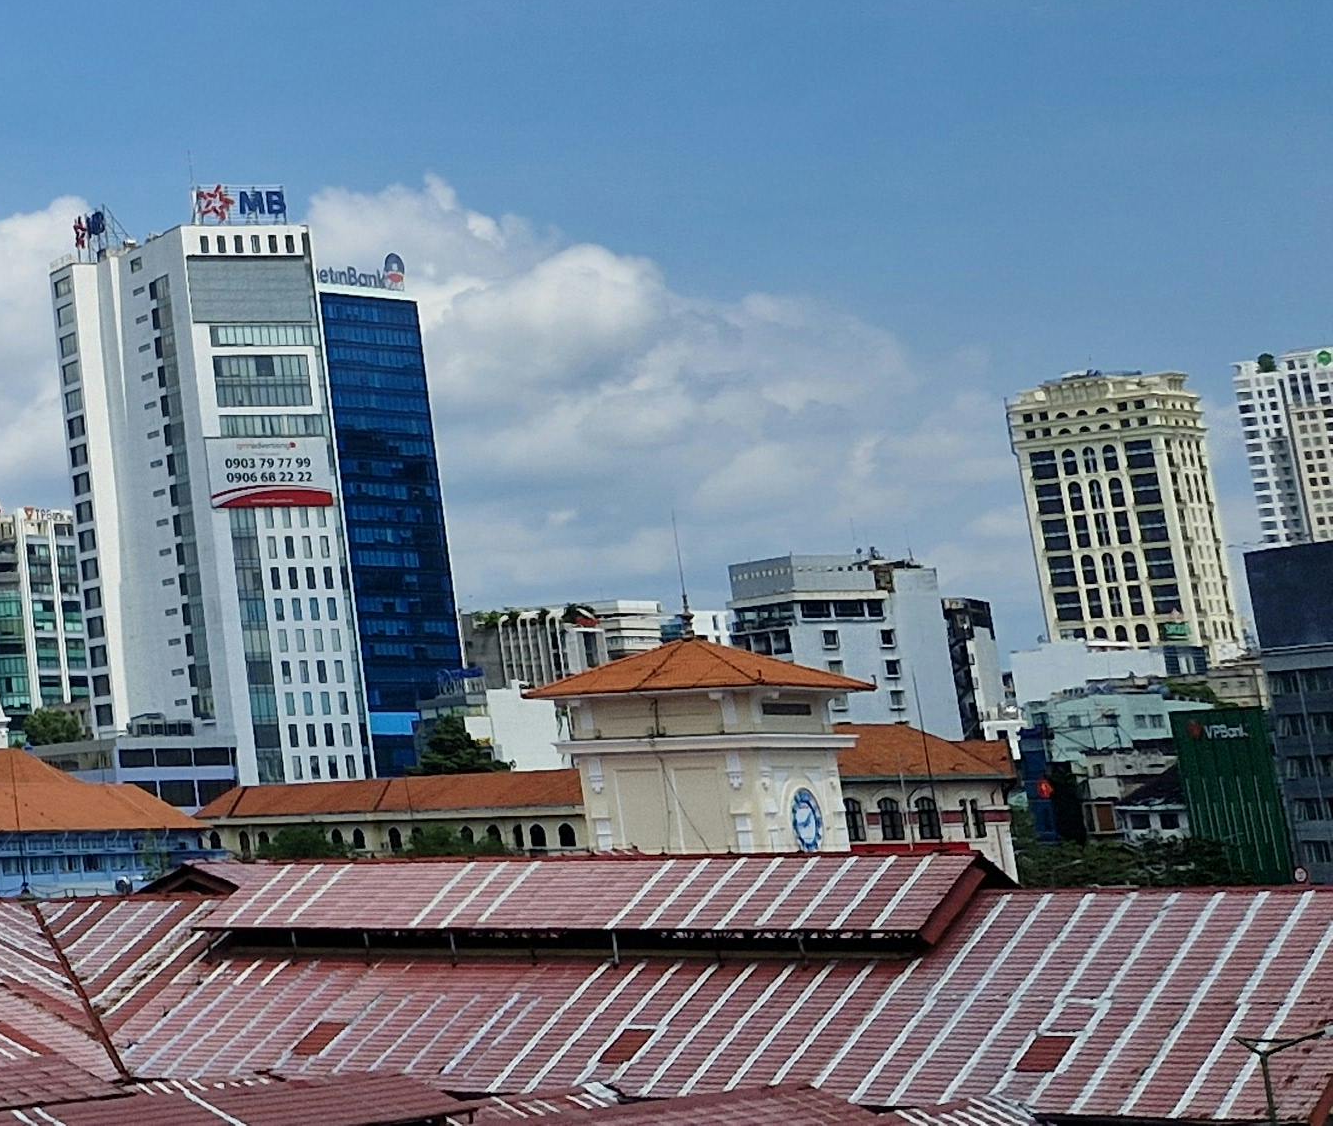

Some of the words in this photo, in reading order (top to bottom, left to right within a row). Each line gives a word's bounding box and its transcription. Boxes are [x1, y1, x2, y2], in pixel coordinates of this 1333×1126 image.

[239, 190, 287, 215] MB
[225, 458, 256, 469] 0903
[260, 458, 275, 468] 79
[278, 458, 293, 468] 77
[296, 457, 311, 468] 99
[226, 472, 258, 483] 0906
[279, 472, 294, 482] 22
[298, 472, 313, 482] 22
[1204, 723, 1249, 739] VPBank
